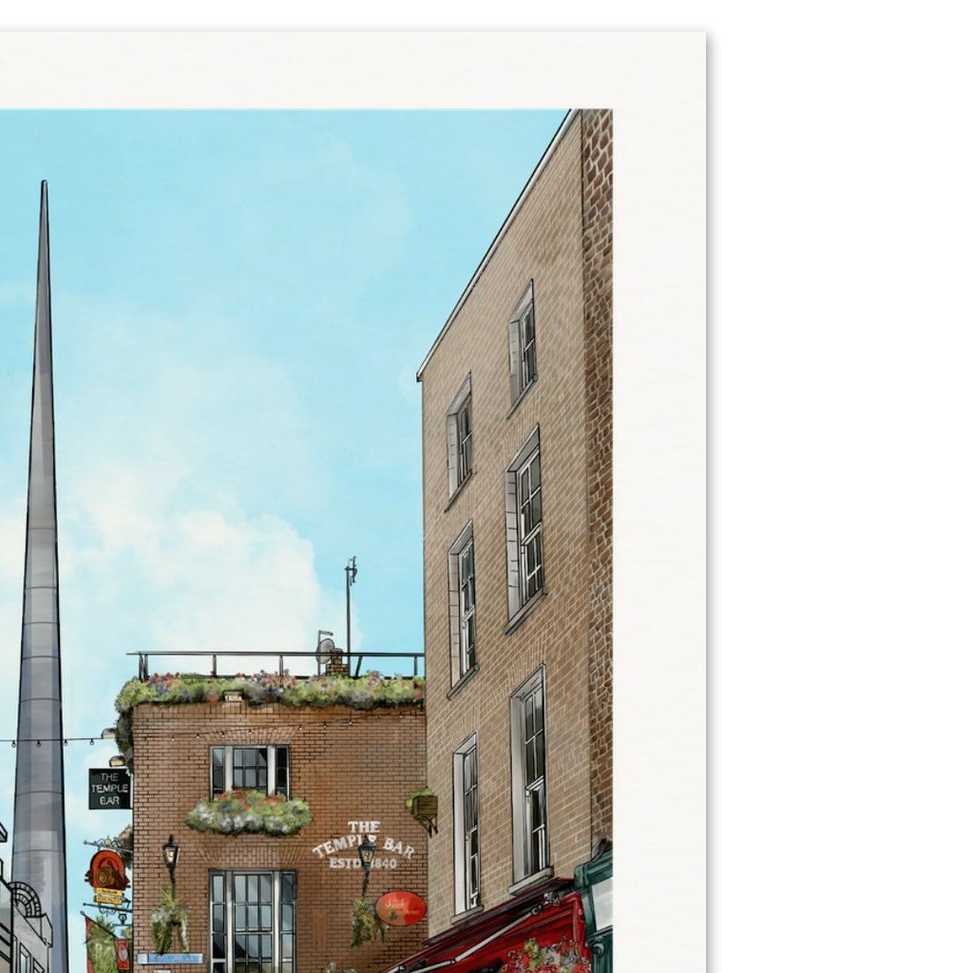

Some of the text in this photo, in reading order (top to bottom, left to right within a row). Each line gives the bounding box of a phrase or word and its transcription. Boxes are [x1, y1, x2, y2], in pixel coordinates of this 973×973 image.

[100, 772, 119, 782] THE
[91, 784, 129, 793] TEMPLE
[99, 796, 120, 805] BAR
[347, 821, 381, 833] THE
[382, 837, 416, 860] BAR
[329, 858, 362, 869] ESTD
